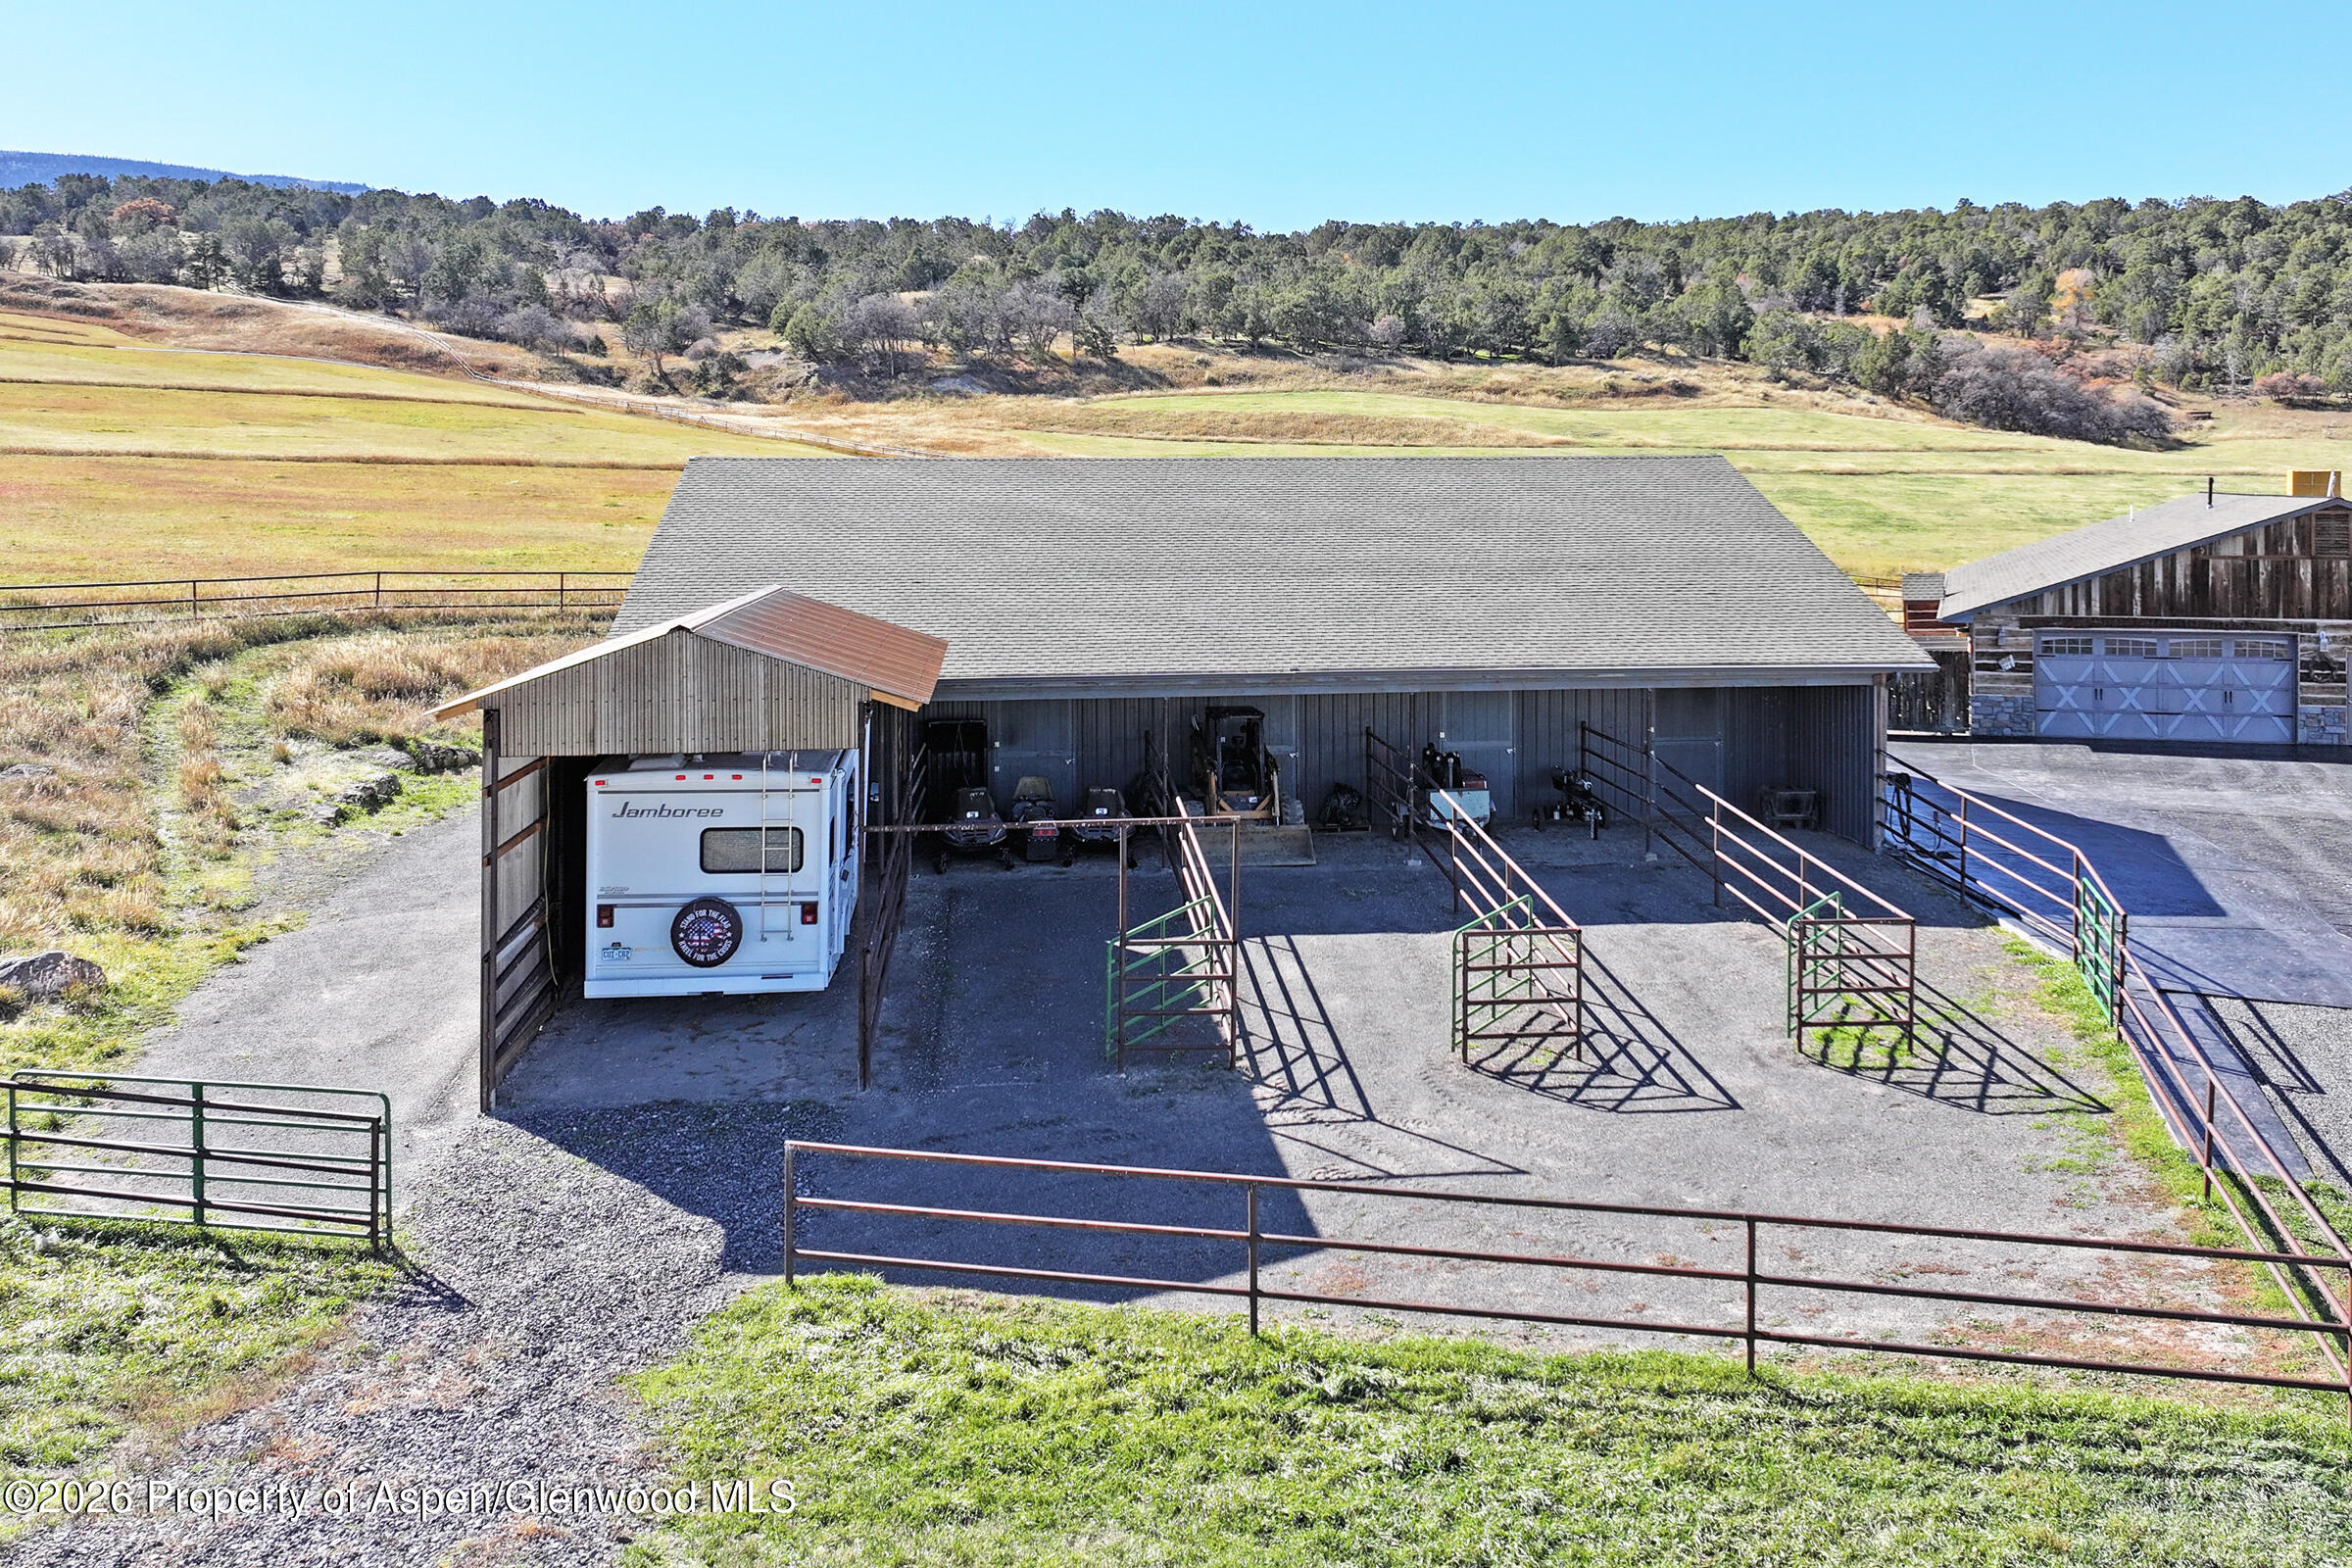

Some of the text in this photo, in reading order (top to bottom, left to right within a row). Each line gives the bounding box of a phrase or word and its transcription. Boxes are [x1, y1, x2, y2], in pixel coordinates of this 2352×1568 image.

[612, 801, 724, 818] Jamboree
[679, 908, 731, 930] STAND FOR THE FLAG
[678, 939, 733, 961] KNEEL FOR THE CROSS
